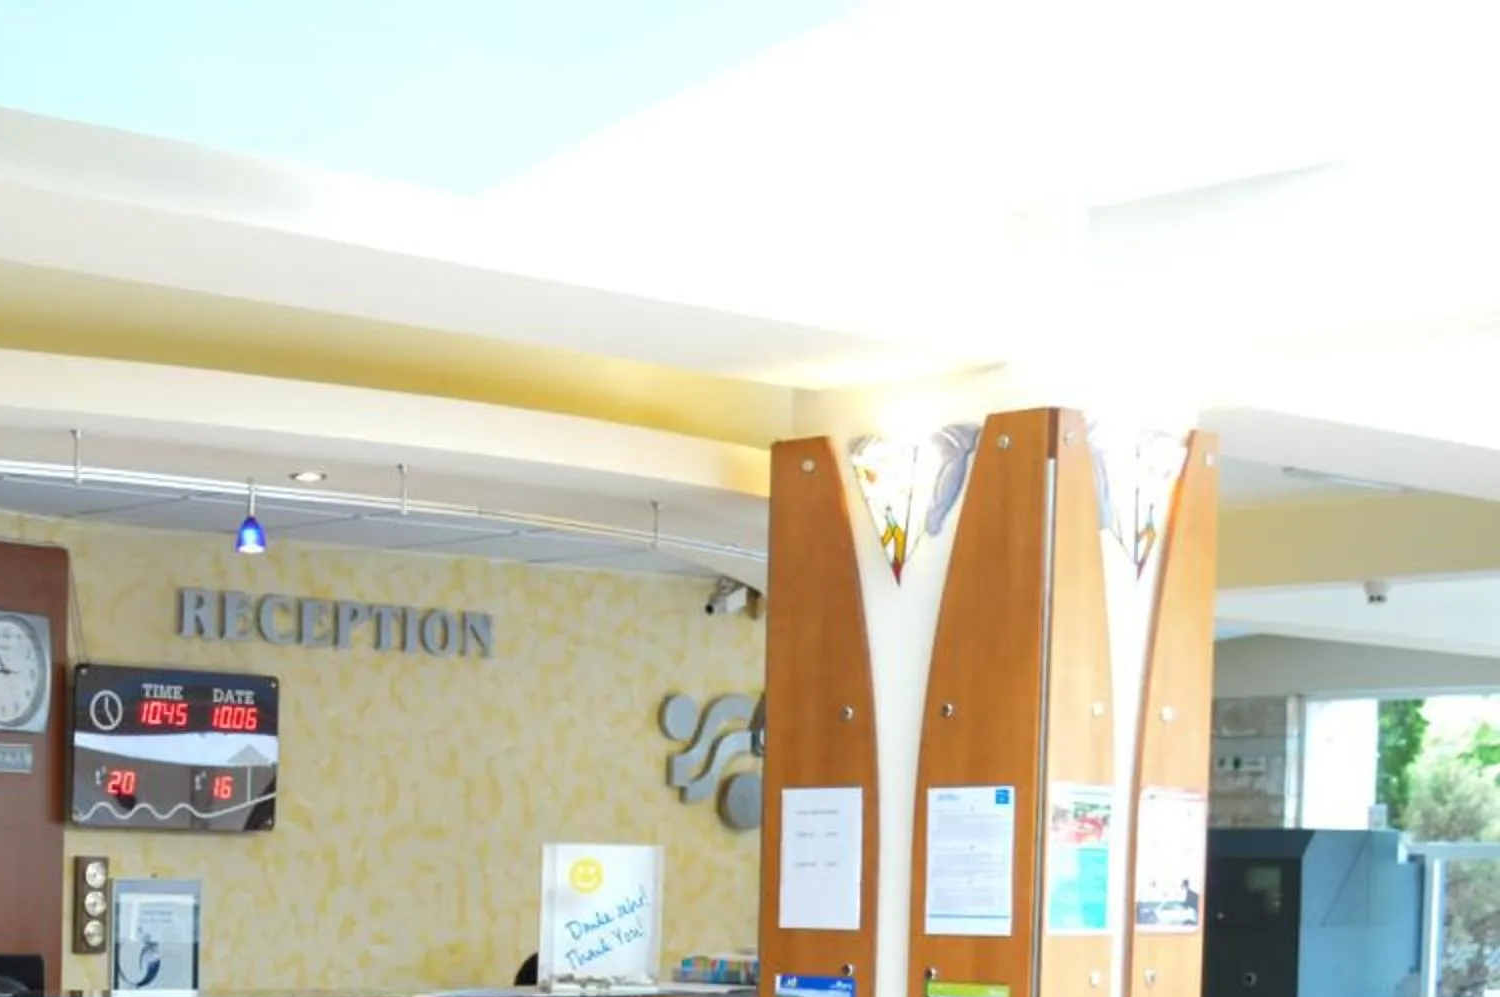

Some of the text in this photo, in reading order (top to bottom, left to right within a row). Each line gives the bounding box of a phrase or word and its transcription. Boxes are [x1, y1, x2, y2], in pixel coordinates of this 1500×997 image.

[177, 587, 495, 659] RECEPTION
[141, 683, 256, 705] TIME DATE
[107, 770, 136, 795] 20
[213, 775, 234, 800] 16
[564, 937, 613, 970] Thank
